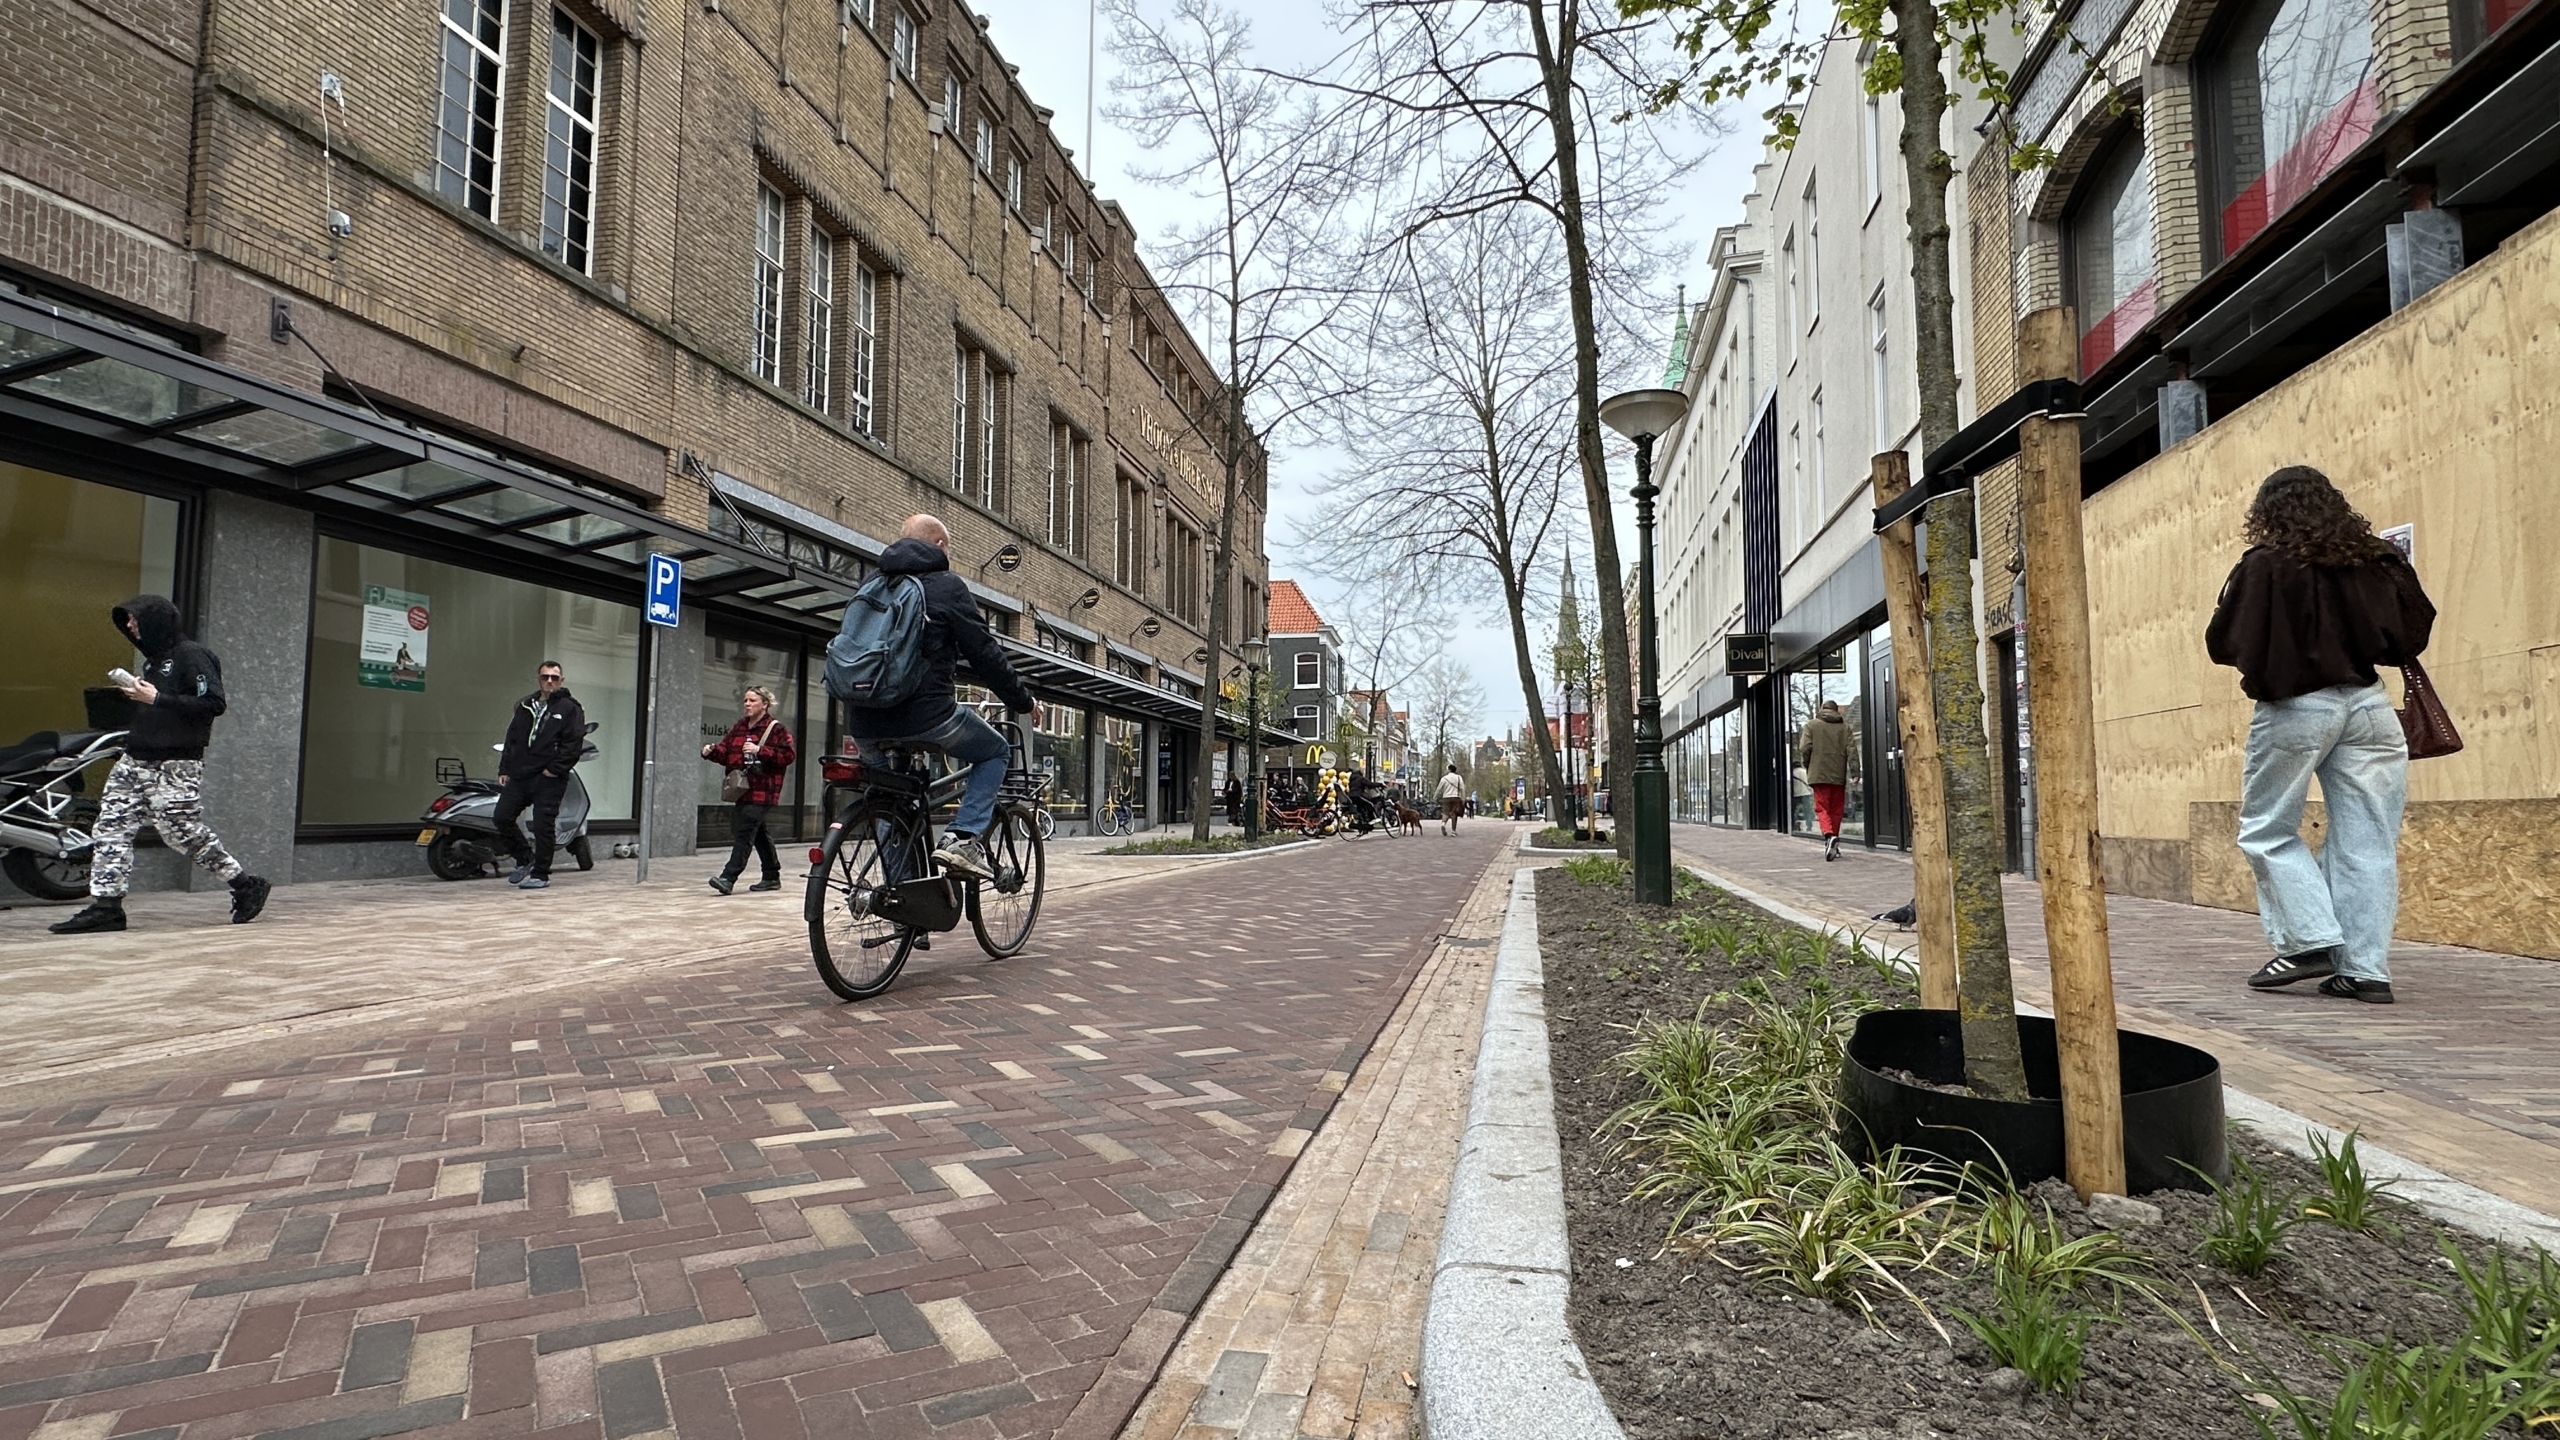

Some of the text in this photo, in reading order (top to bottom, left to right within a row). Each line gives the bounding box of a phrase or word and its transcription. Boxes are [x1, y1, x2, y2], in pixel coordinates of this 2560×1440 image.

[1140, 404, 1174, 466] VROOM
[656, 561, 675, 595] P
[1731, 648, 1764, 660] Divali
